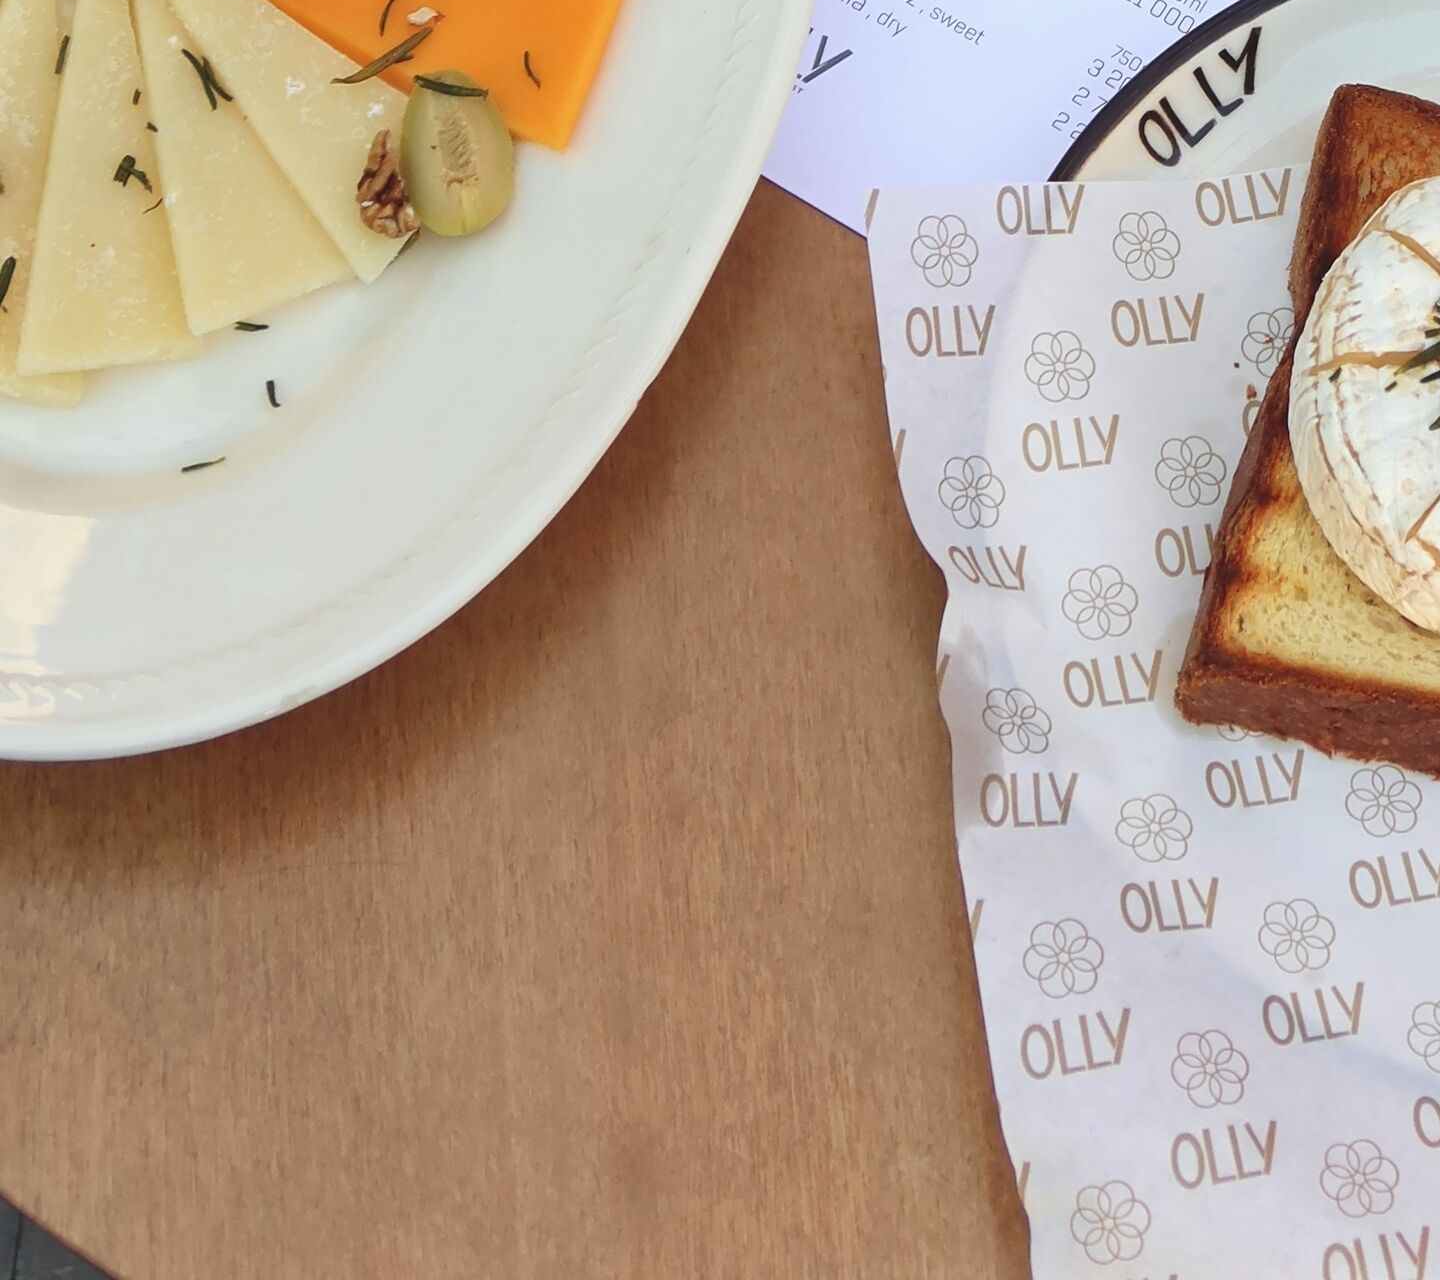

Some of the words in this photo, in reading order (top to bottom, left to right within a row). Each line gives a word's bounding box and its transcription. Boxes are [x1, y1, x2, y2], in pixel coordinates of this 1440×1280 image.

[1138, 27, 1263, 168] OLLY
[1196, 168, 1291, 226] OLLY
[1111, 293, 1204, 347] OLLY
[1022, 414, 1119, 472] OLLY
